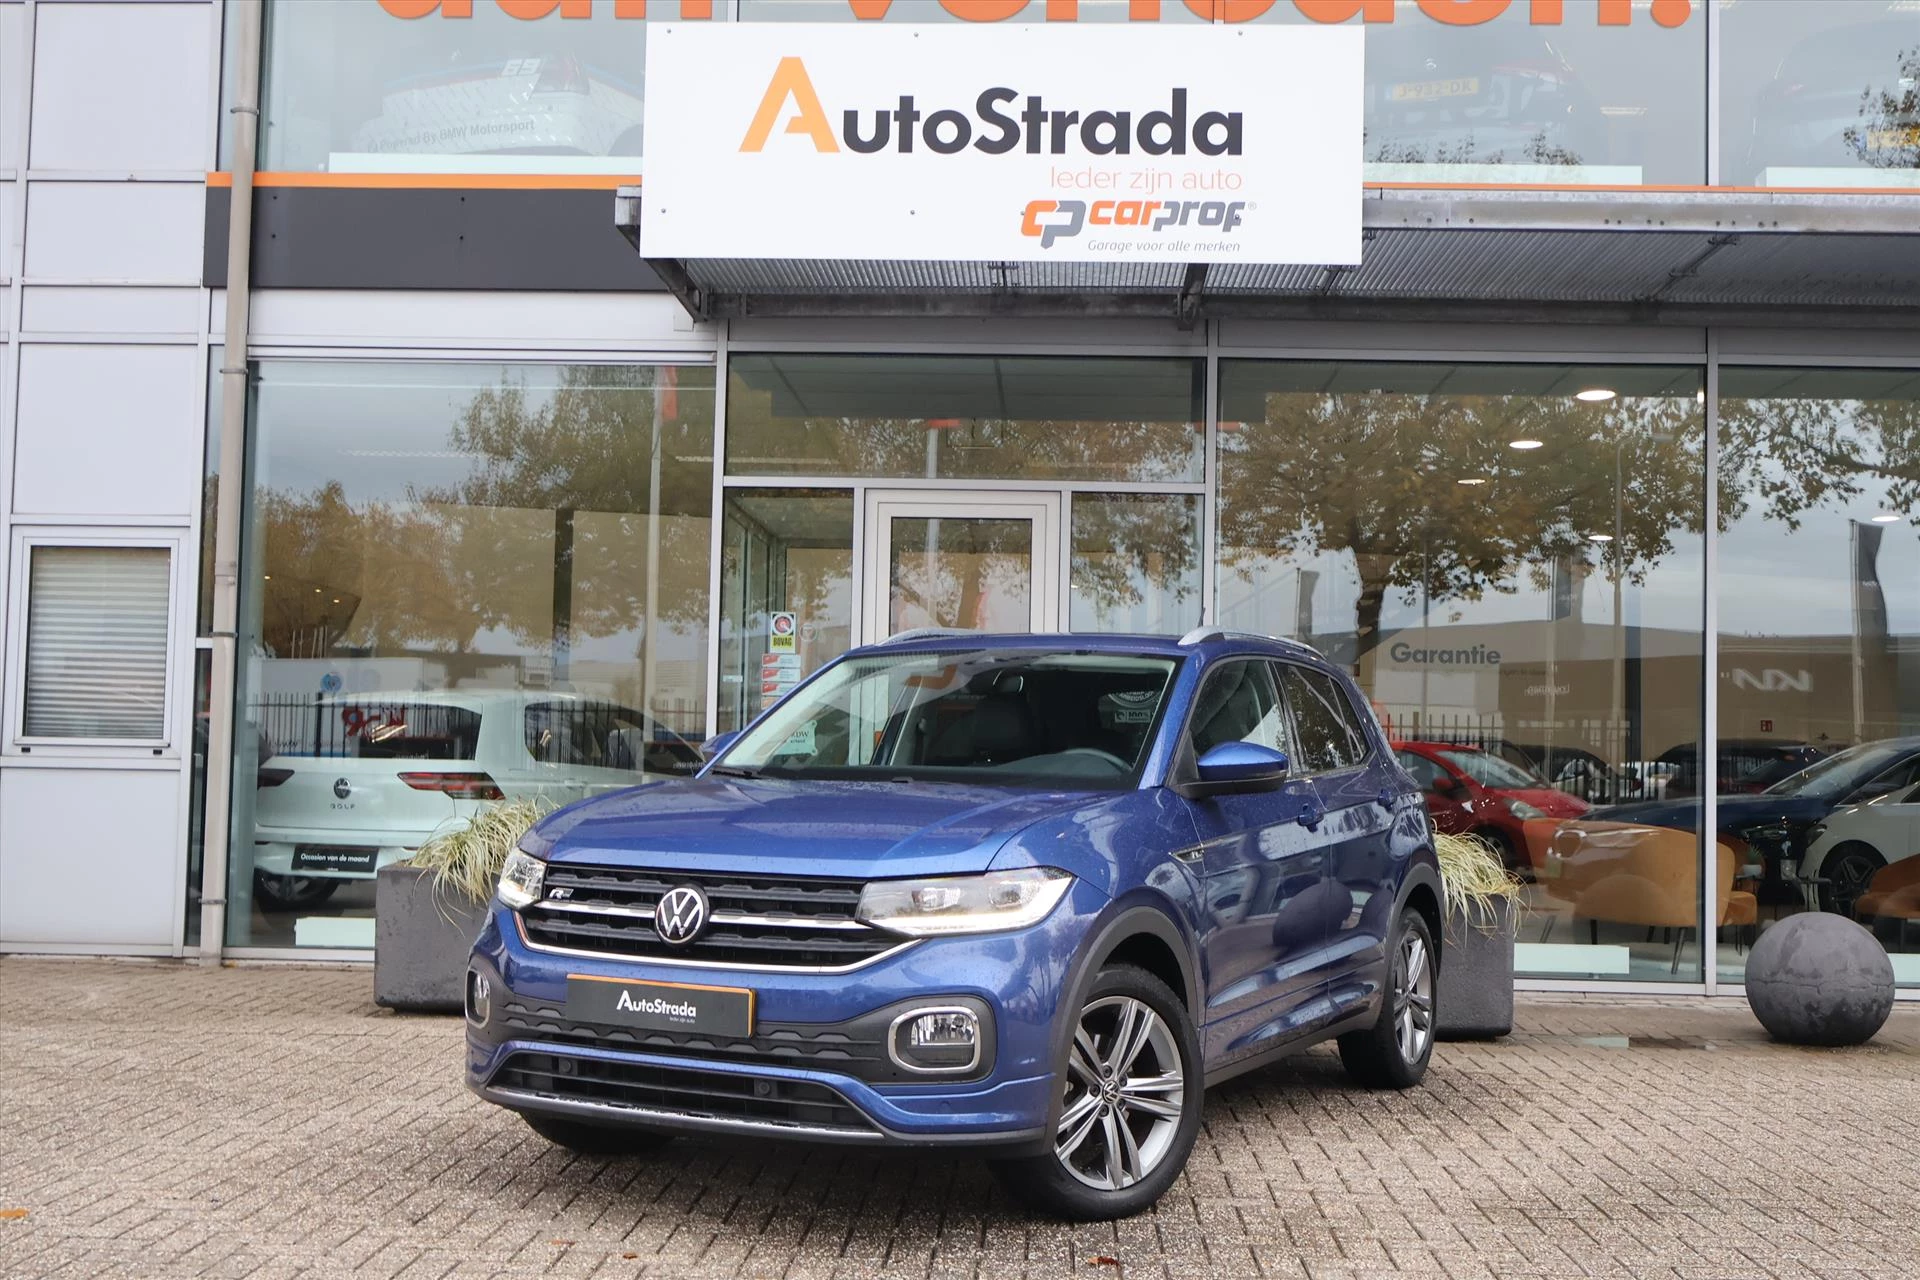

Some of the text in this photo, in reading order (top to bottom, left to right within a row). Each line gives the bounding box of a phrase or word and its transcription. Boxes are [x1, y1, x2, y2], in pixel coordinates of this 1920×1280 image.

[738, 57, 1242, 156] AutoStrada
[440, 126, 468, 140] BMW
[470, 119, 536, 138] Motorsport
[1051, 166, 1242, 195] Ieder zijn auto
[1088, 240, 1241, 253] Garage voor alle merken
[1390, 642, 1501, 665] Garantie
[300, 853, 326, 861] Occasion
[339, 854, 347, 862] de
[347, 855, 370, 863] maand
[616, 989, 697, 1018] AutoStrada
